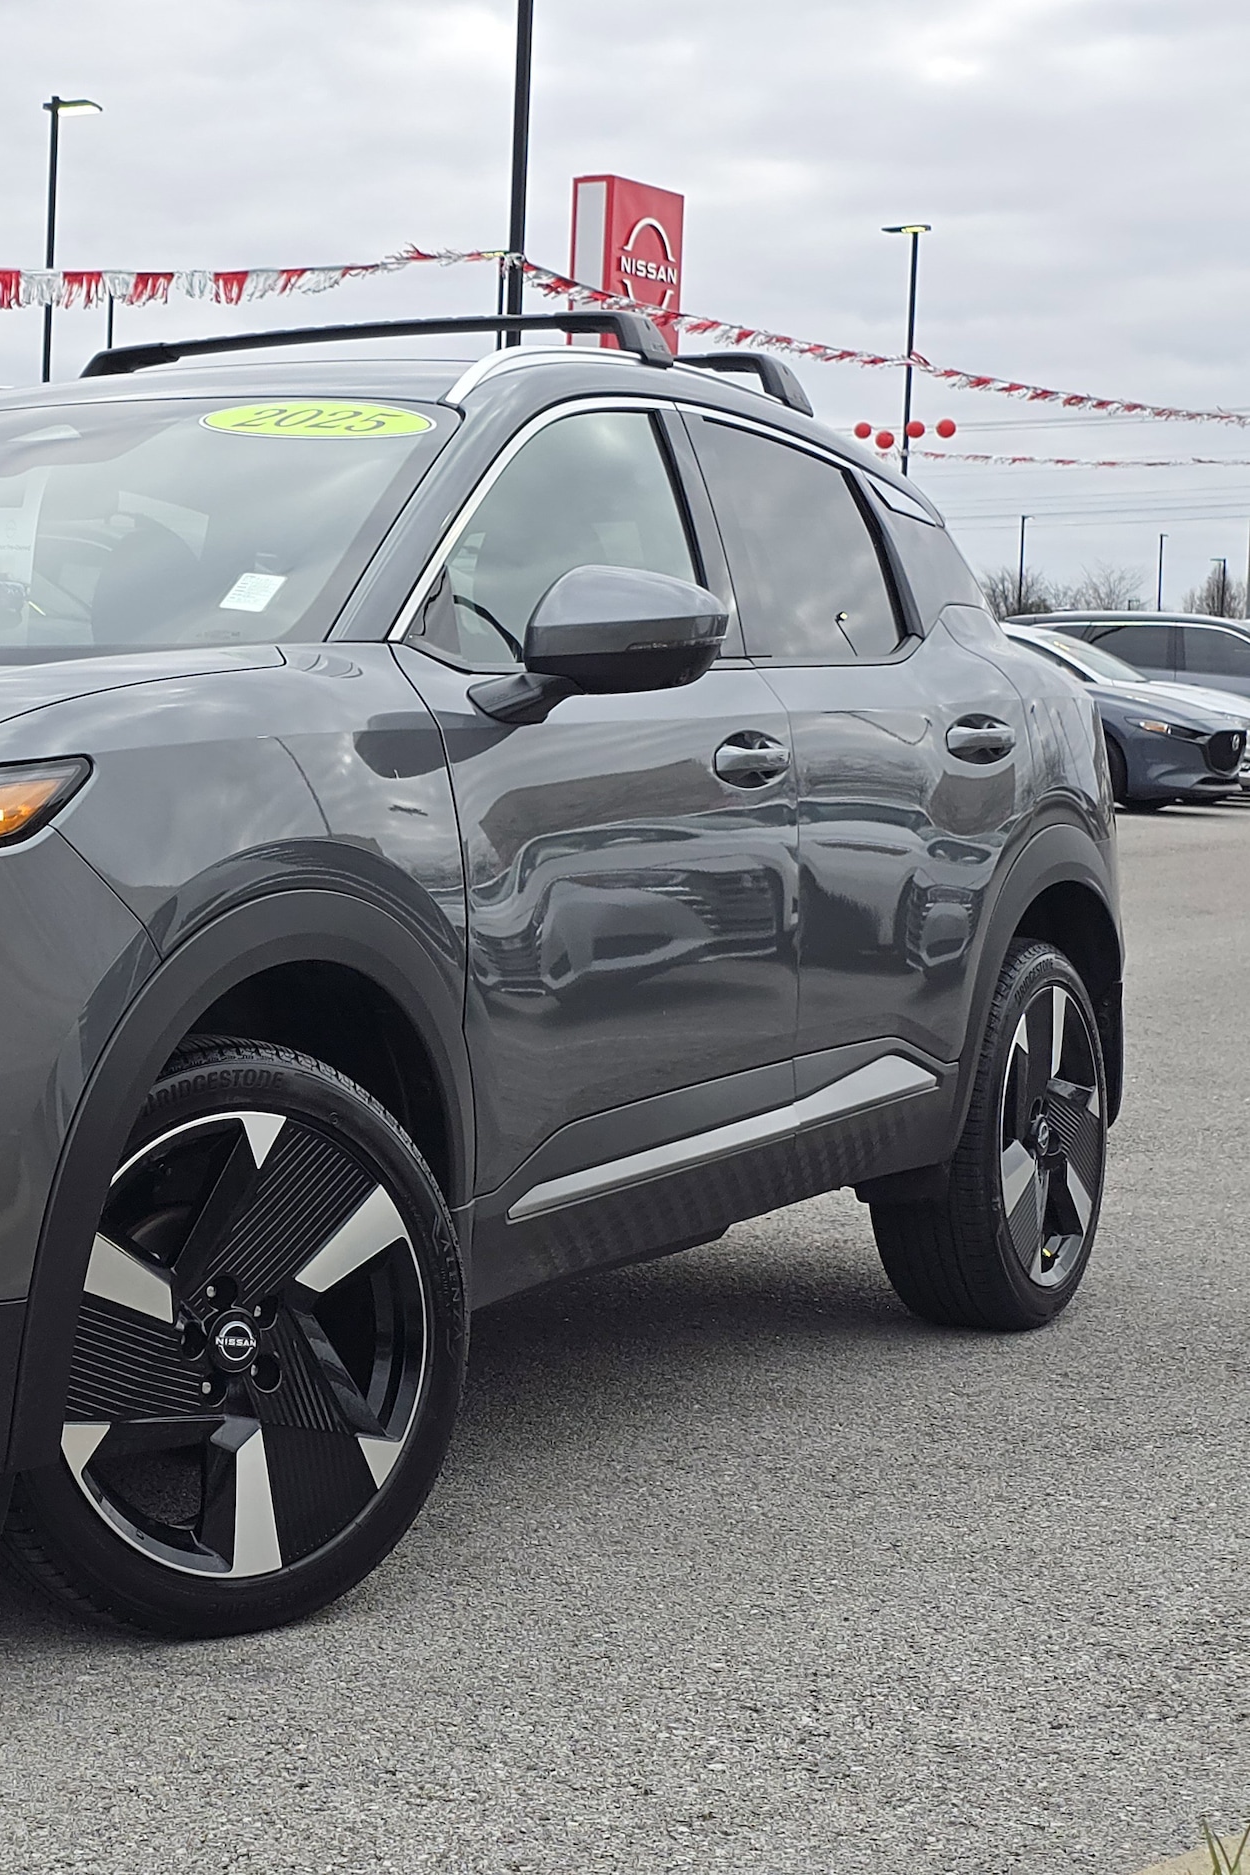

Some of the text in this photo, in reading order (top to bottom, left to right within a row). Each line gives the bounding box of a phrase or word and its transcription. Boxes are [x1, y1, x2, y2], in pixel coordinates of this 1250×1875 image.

[621, 255, 677, 285] NISSAN
[232, 407, 403, 433] 2025
[215, 1336, 257, 1348] NISSAN
